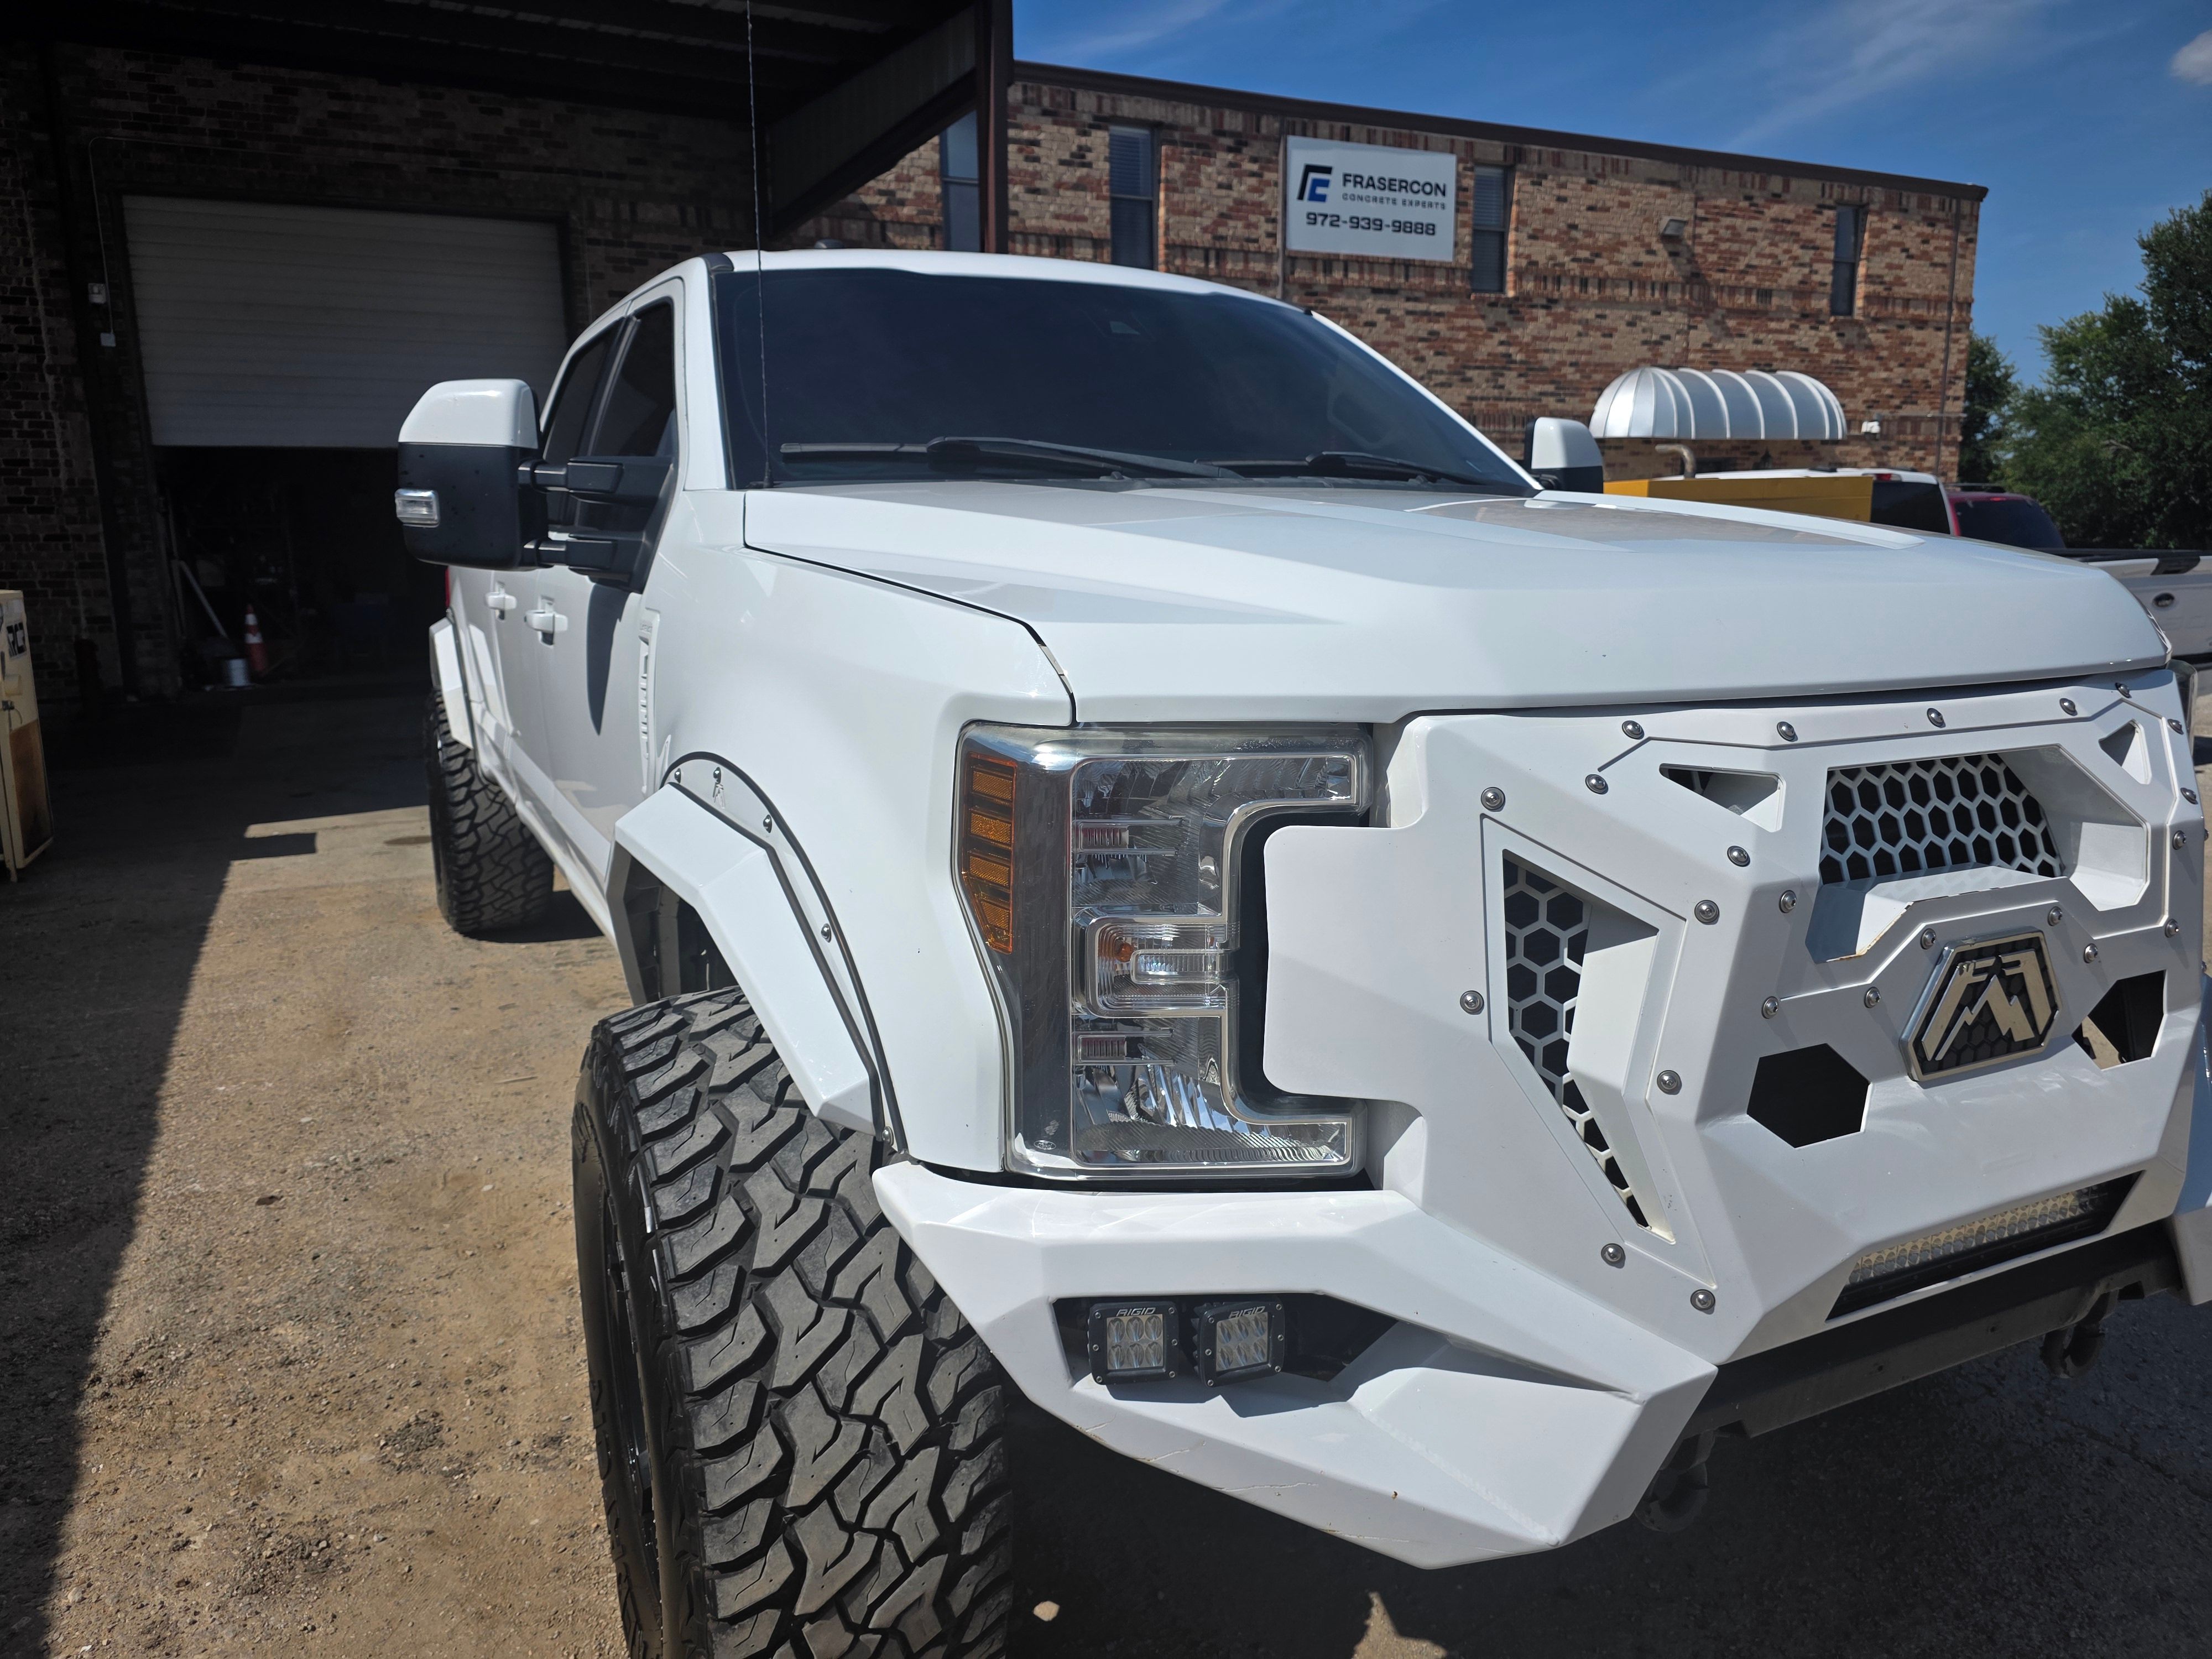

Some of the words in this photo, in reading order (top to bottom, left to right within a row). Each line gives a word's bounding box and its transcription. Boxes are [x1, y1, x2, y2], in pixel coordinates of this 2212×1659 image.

[1342, 173, 1446, 196] FRASERCON
[1342, 193, 1397, 205] CONCRETE
[1402, 199, 1447, 210] EXPERTS
[1307, 212, 1436, 236] 972-939-9888
[1116, 1307, 1156, 1317] RIGID
[1228, 1306, 1266, 1319] RIGID
